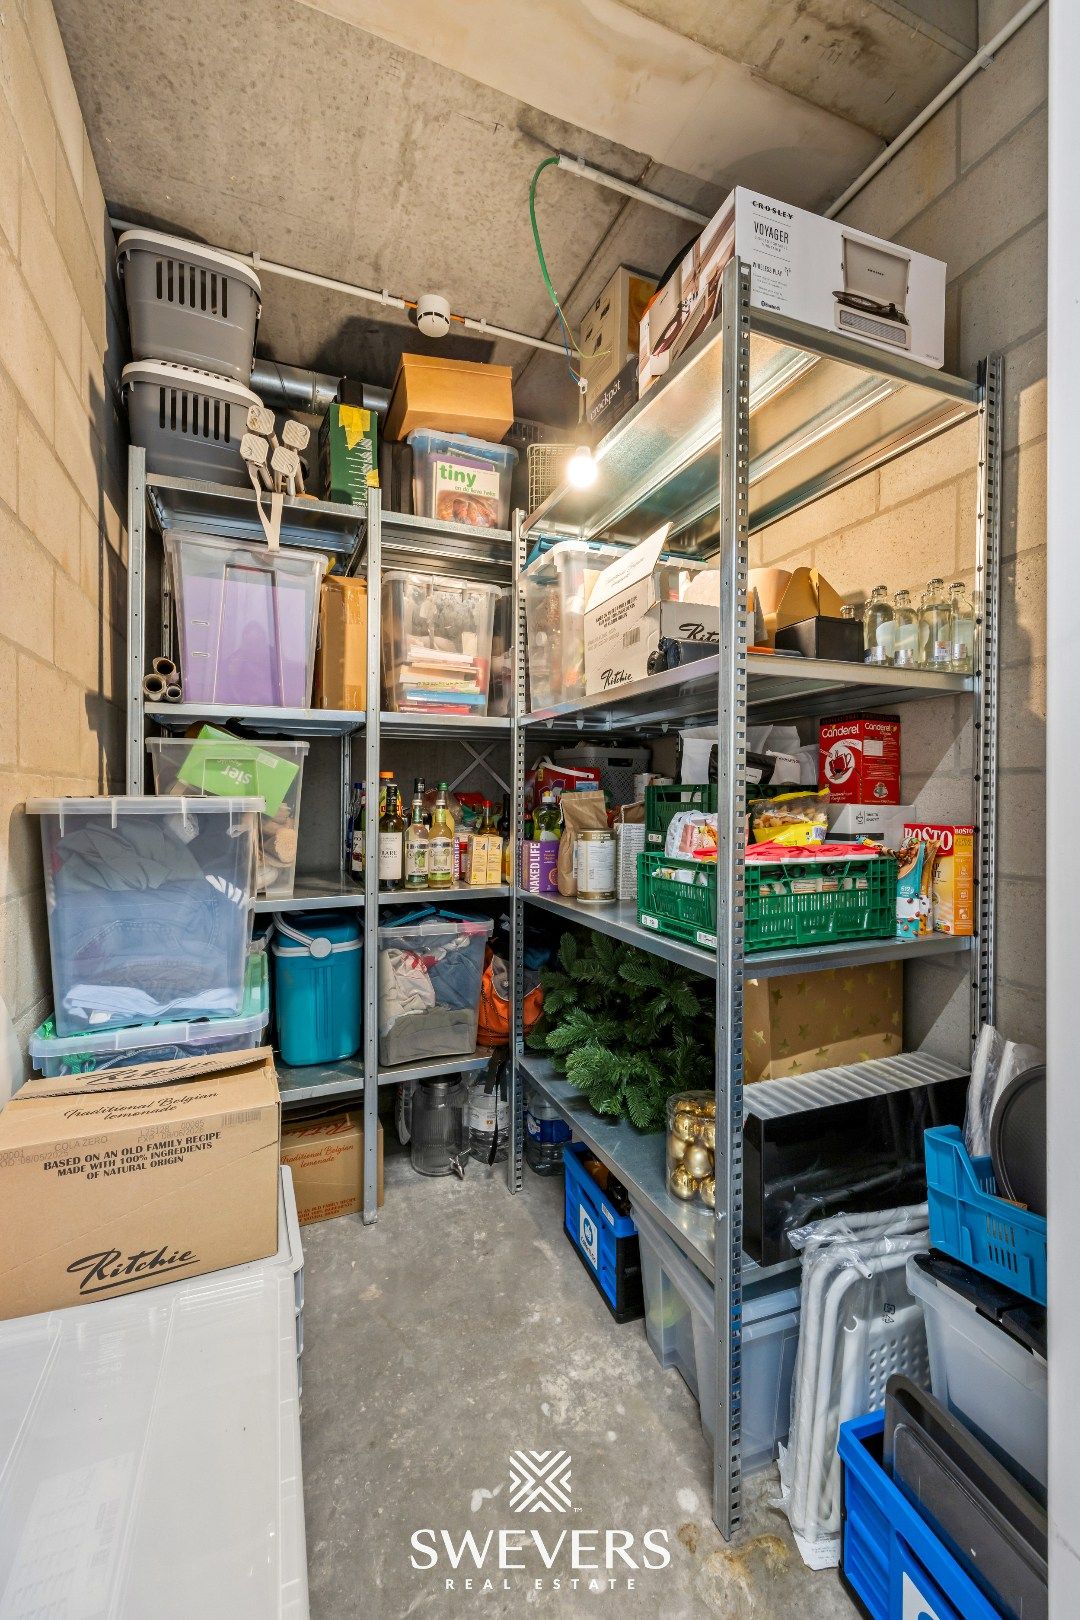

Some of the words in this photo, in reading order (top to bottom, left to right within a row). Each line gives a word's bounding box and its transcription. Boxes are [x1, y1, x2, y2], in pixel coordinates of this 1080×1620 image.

[752, 200, 794, 220] CROSLEY
[754, 221, 789, 244] VOYAGER
[590, 379, 621, 420] crockpot
[440, 464, 476, 486] tiny
[601, 669, 632, 690] Ritchie
[822, 724, 860, 738] Canderel
[864, 722, 891, 732] Canderel
[530, 842, 540, 862] LIFE
[530, 863, 540, 893] NAKED
[64, 1098, 150, 1120] Traditional
[154, 1090, 218, 1110] Belgian
[104, 1106, 178, 1120] lemonade
[44, 1156, 81, 1170] BASED
[84, 1154, 100, 1162] ON
[104, 1150, 118, 1160] AN
[121, 1145, 143, 1156] OLD
[146, 1138, 183, 1152] FAMILY
[186, 1132, 221, 1145] RECIPE
[82, 1136, 108, 1147] ZERO
[324, 1144, 354, 1156] Belgian
[58, 1164, 87, 1177] MADE
[90, 1160, 116, 1170] WITH
[120, 1154, 148, 1165] 100%
[150, 1142, 212, 1160] INGREDIENTS
[86, 1171, 100, 1180] OF
[103, 1161, 147, 1177] NATURAL
[150, 1156, 184, 1168] ORIGIN
[300, 1156, 335, 1168] lemonade
[67, 1246, 200, 1294] Ritchie
